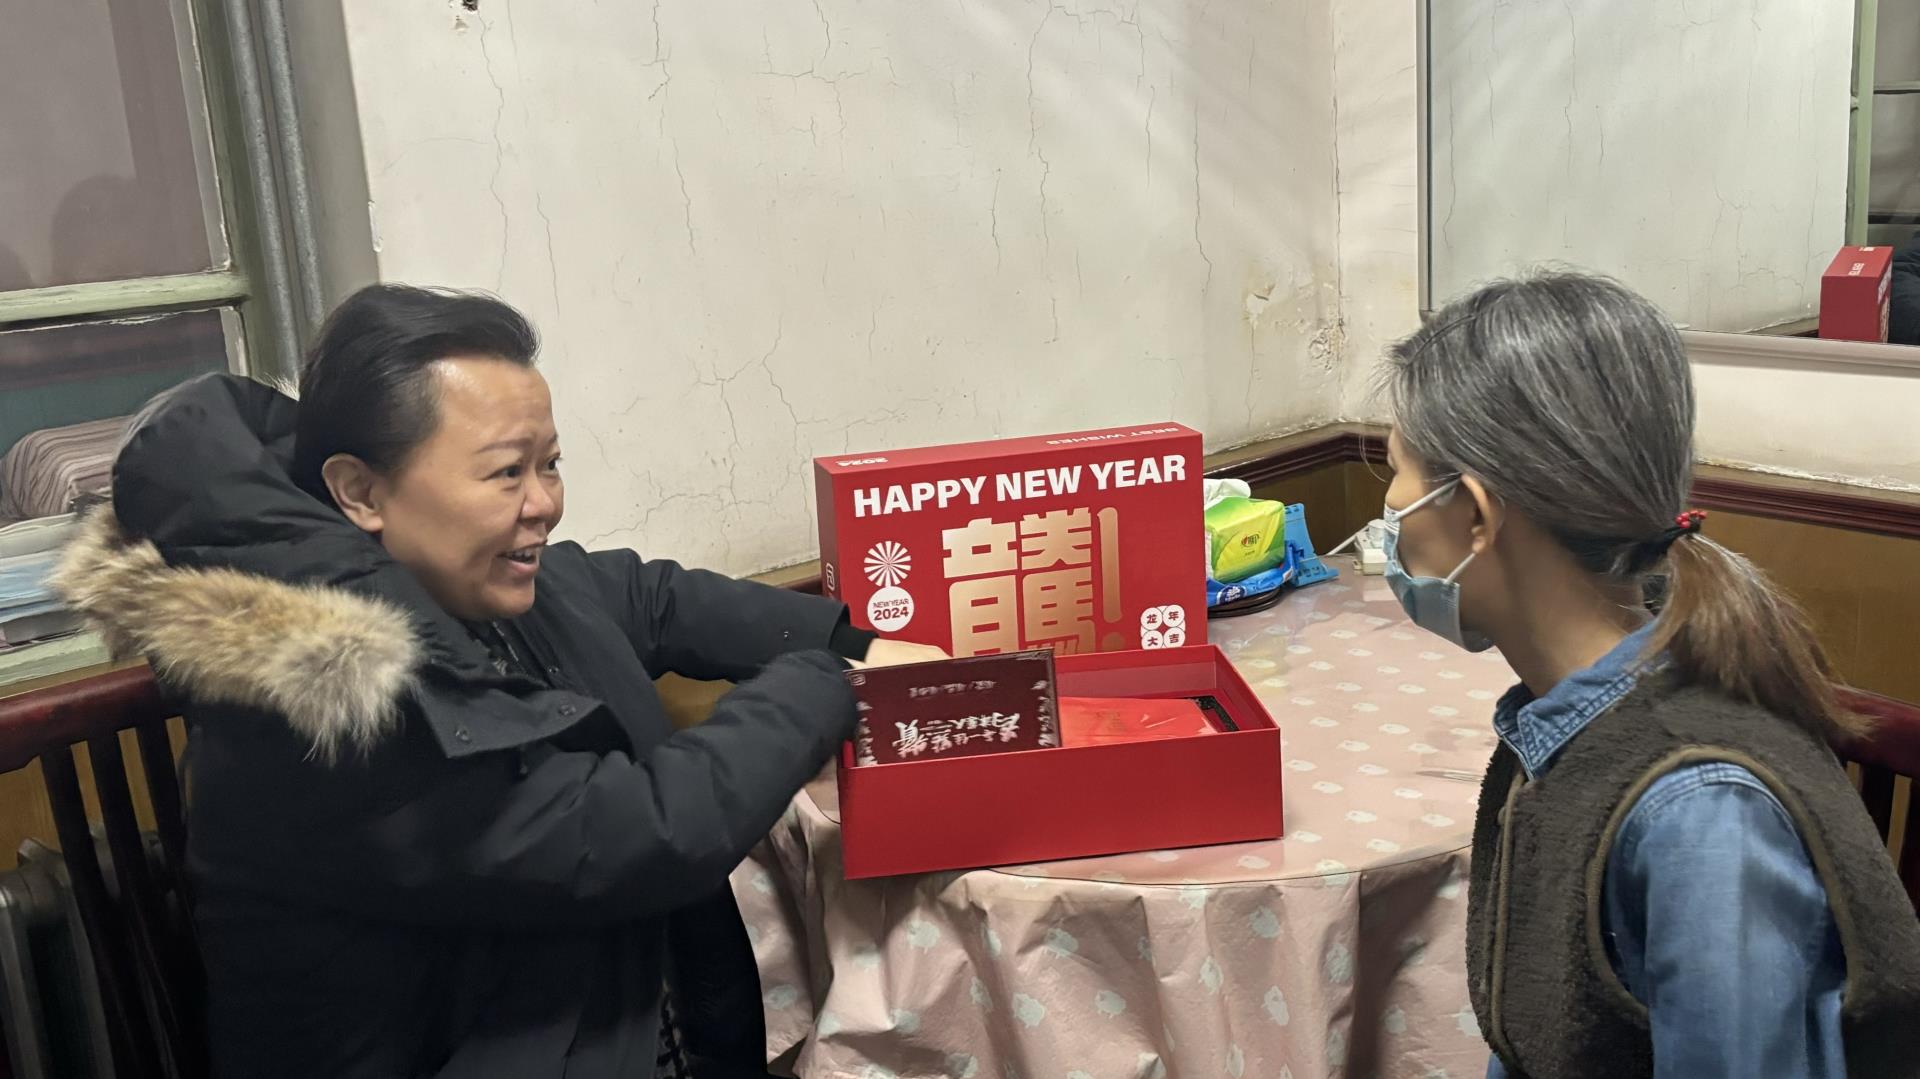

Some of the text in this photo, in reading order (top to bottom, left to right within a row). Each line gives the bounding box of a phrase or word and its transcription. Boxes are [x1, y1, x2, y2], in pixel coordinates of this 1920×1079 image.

[1046, 427, 1179, 444] BEST WISHES
[835, 456, 889, 466] 2024
[853, 454, 1186, 518] HAPPY NEW YEAR
[889, 598, 909, 606] YEAR
[873, 606, 909, 621] 2024
